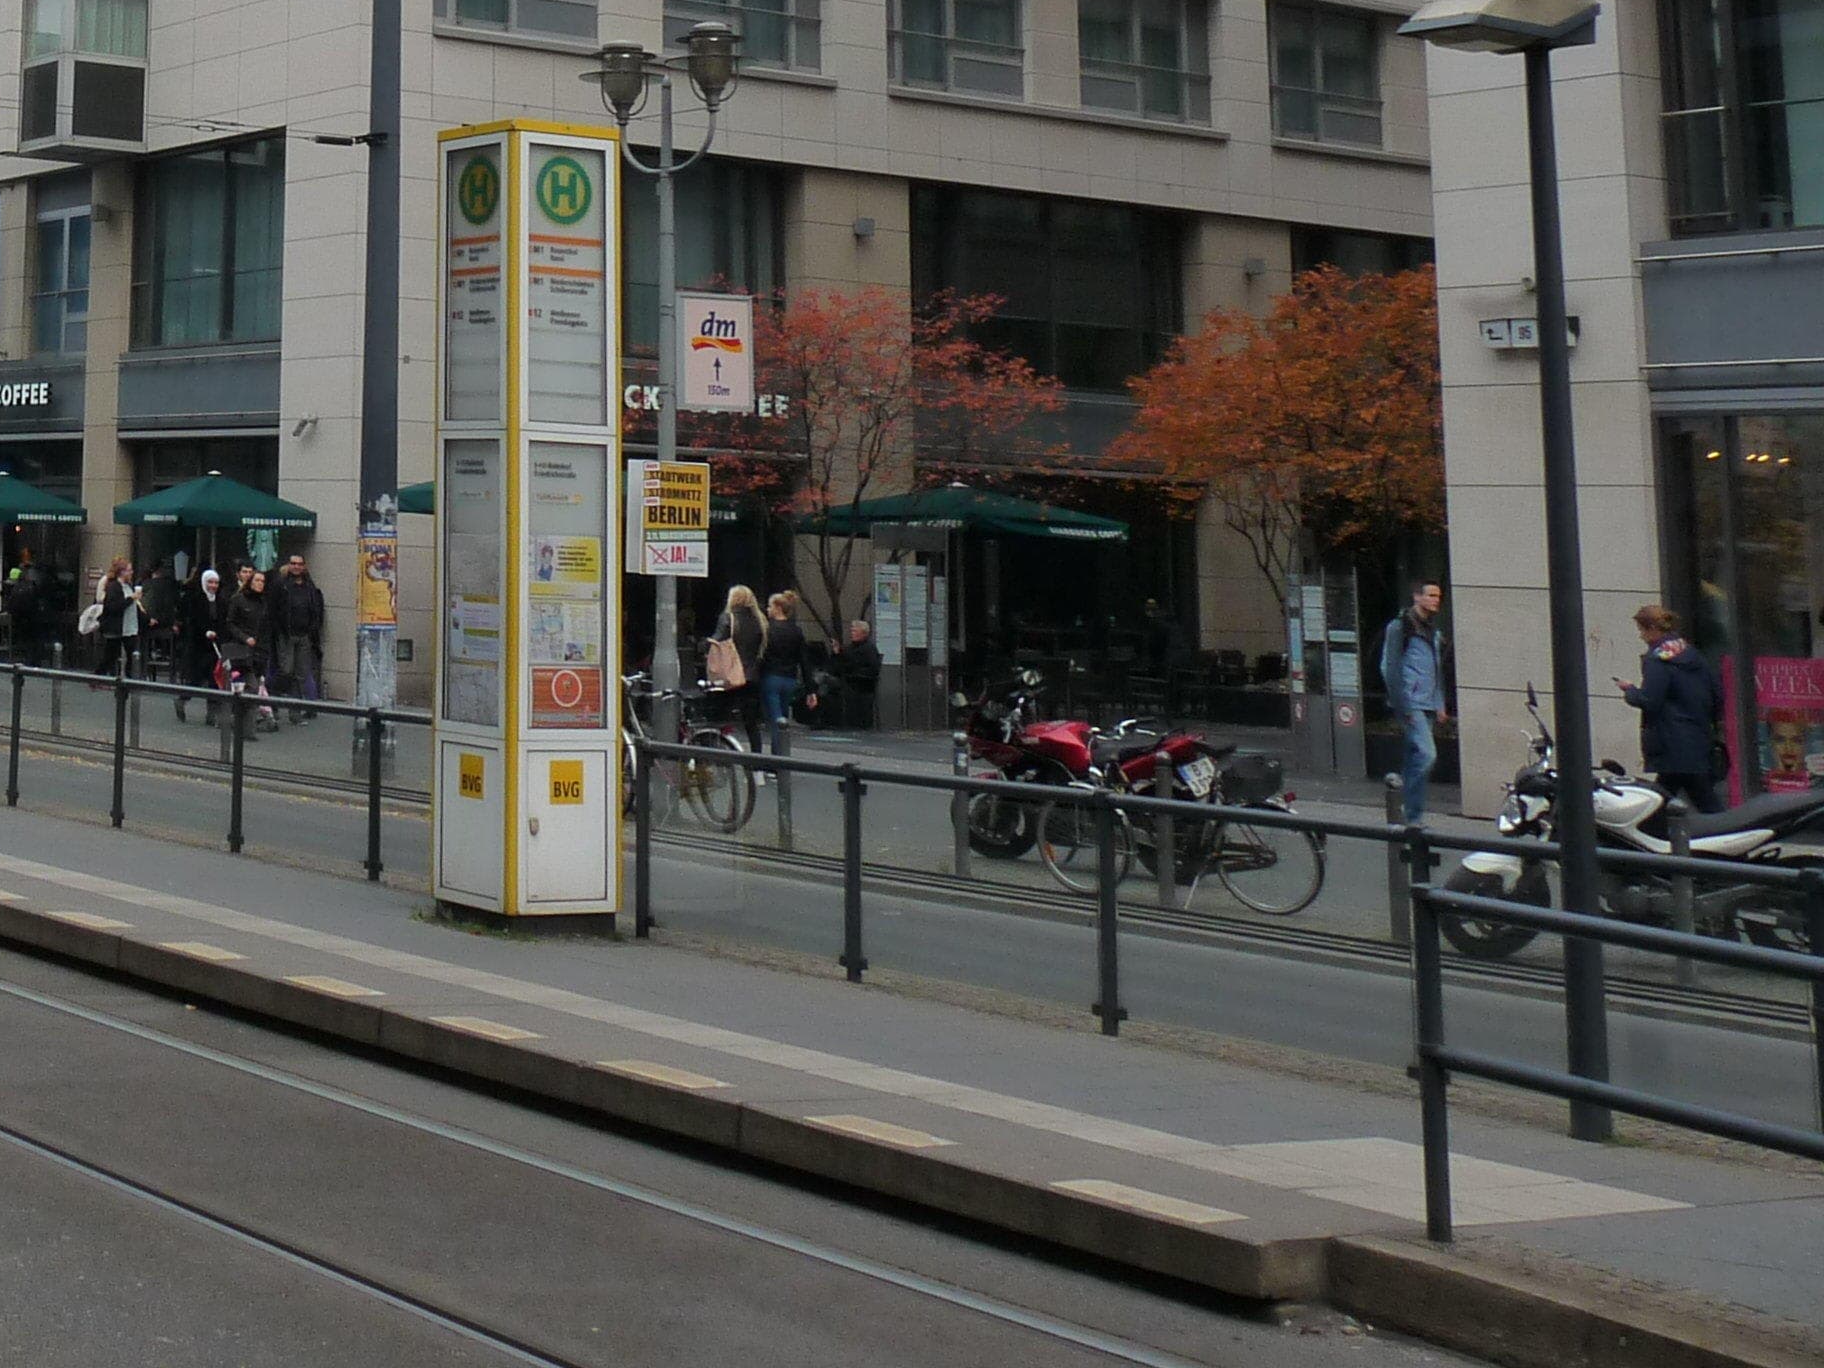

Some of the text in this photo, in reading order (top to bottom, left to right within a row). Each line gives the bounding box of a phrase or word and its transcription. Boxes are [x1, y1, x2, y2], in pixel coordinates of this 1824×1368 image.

[701, 311, 736, 337] dm
[708, 385, 730, 396] 150m
[648, 470, 702, 485] STADTWERK
[648, 487, 702, 502] STROMNETZ
[648, 505, 702, 526] BERLIN
[670, 544, 687, 563] JA!
[462, 774, 482, 793] BVG
[553, 781, 580, 798] BVG
